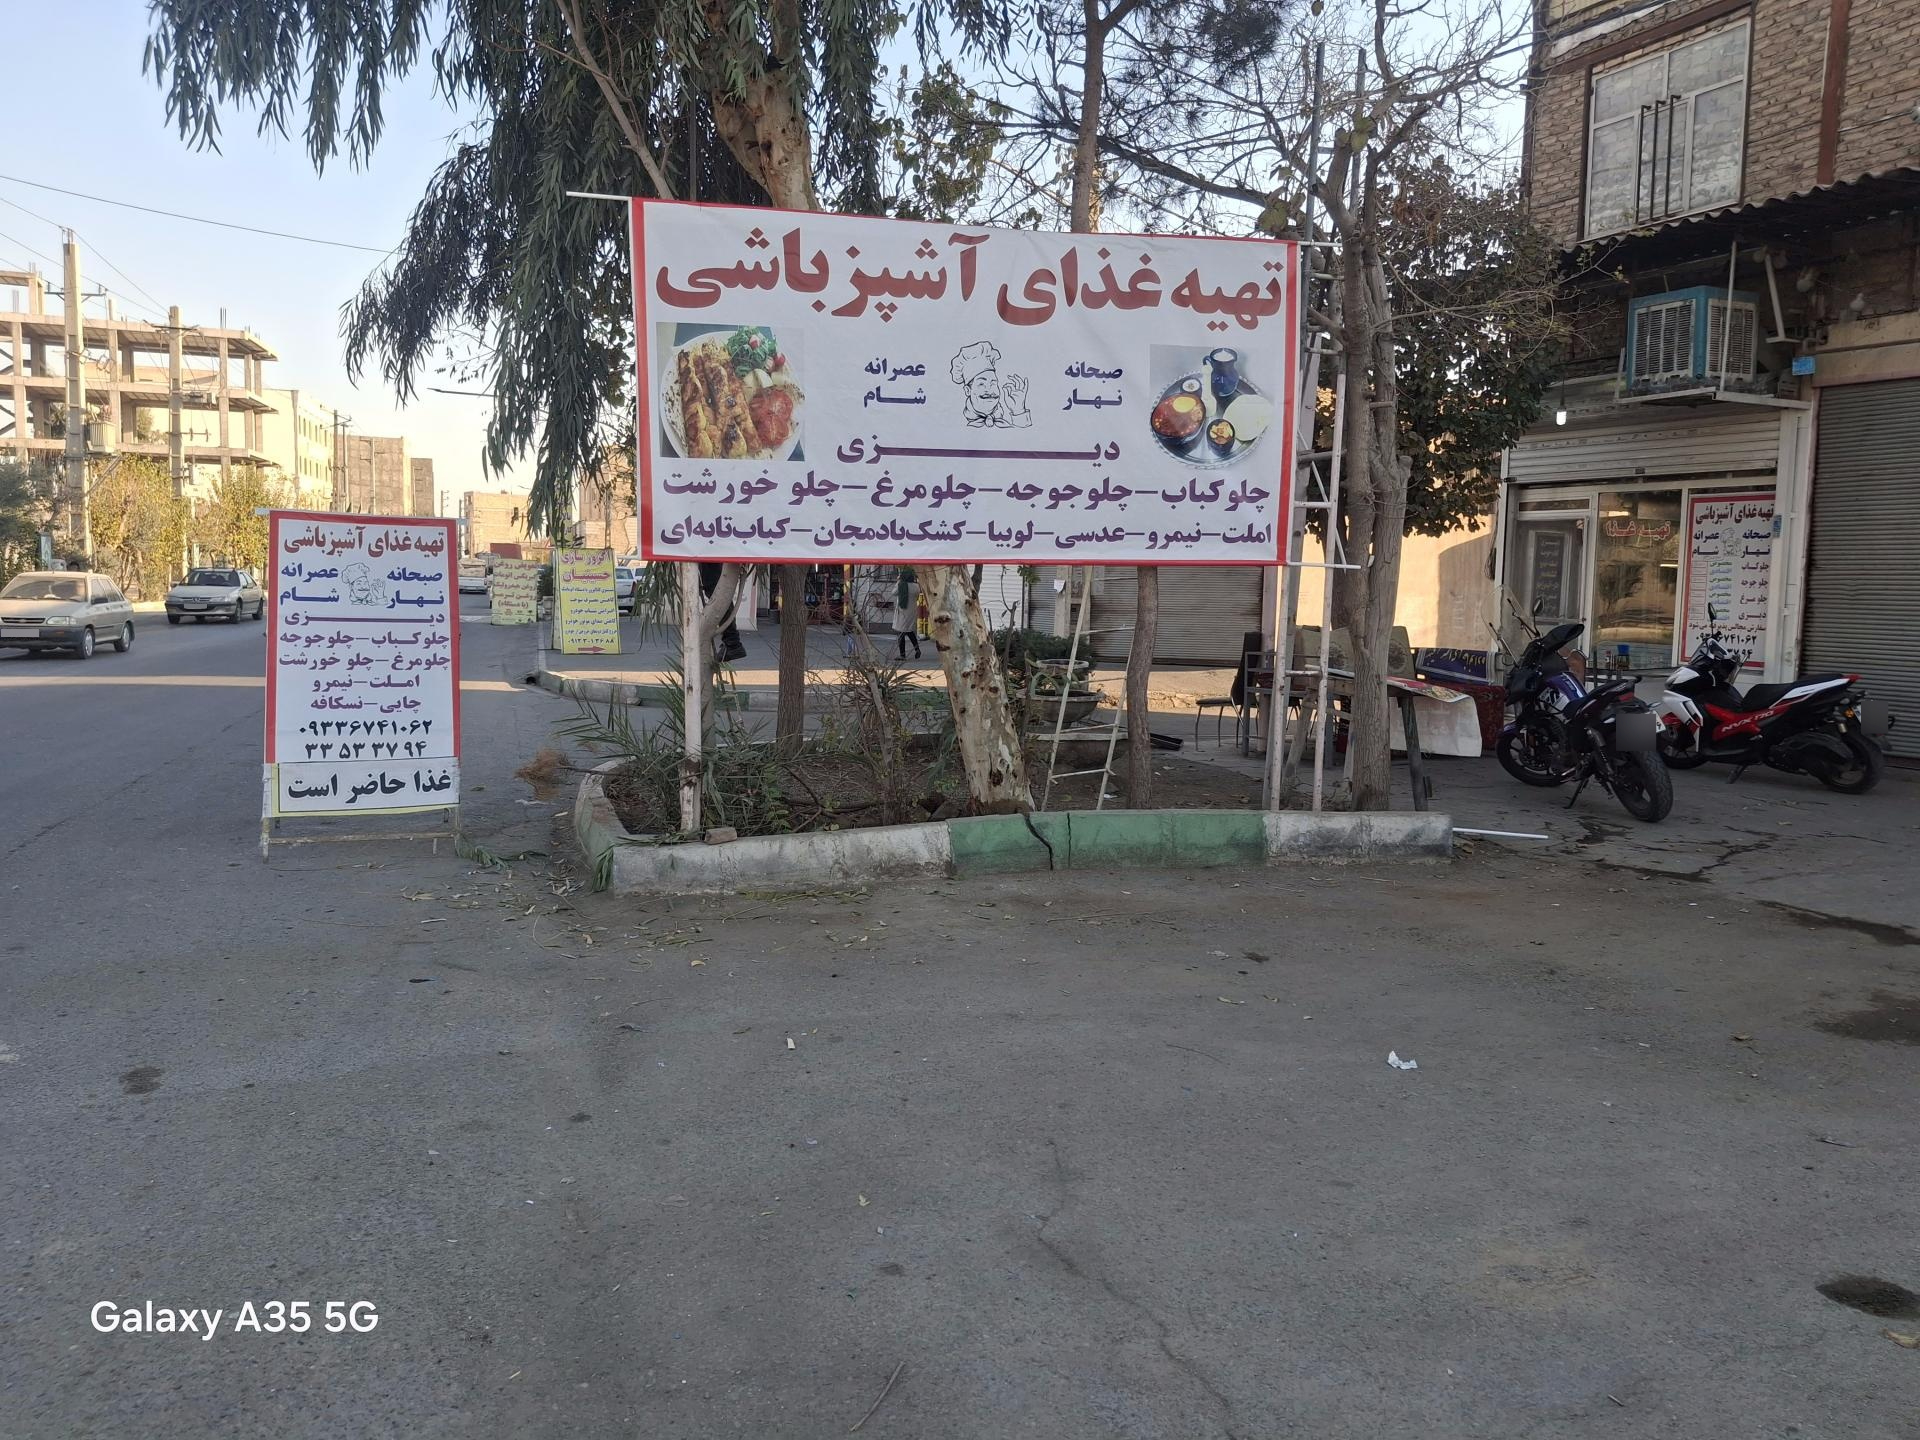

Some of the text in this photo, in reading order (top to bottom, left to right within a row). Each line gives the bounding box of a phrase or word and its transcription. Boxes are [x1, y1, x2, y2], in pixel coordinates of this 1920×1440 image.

[997, 246, 1162, 326] غذای
[1171, 258, 1284, 331] تهیه
[864, 357, 926, 382] عصرانه
[1064, 361, 1123, 384] صبحانه
[863, 385, 927, 408] شام
[1062, 388, 1123, 410] نهار
[837, 434, 1121, 467] دیزی
[663, 468, 779, 504] خورشت
[1734, 503, 1757, 524] غذای
[1757, 503, 1775, 522] تهیه
[1221, 523, 1272, 545] املت
[1605, 520, 1671, 541] تهیه غذا
[1693, 529, 1720, 543] عصرانه
[1742, 529, 1771, 541] صبحانه
[367, 529, 413, 558] غذای
[414, 531, 445, 558] تهیه
[1692, 546, 1720, 558] شام
[1740, 545, 1771, 558] نهار
[281, 563, 339, 583] عصرانه
[386, 566, 443, 586] صبحانه
[279, 586, 340, 606] شام
[386, 589, 445, 609] نهار
[284, 611, 445, 627] دیزی
[279, 651, 342, 671] خورشت
[310, 695, 364, 711] نسکافه
[299, 719, 433, 737] ۰۹۳۳۶۷۴۱۰۶۲
[288, 768, 452, 804] غذا حاضر است
